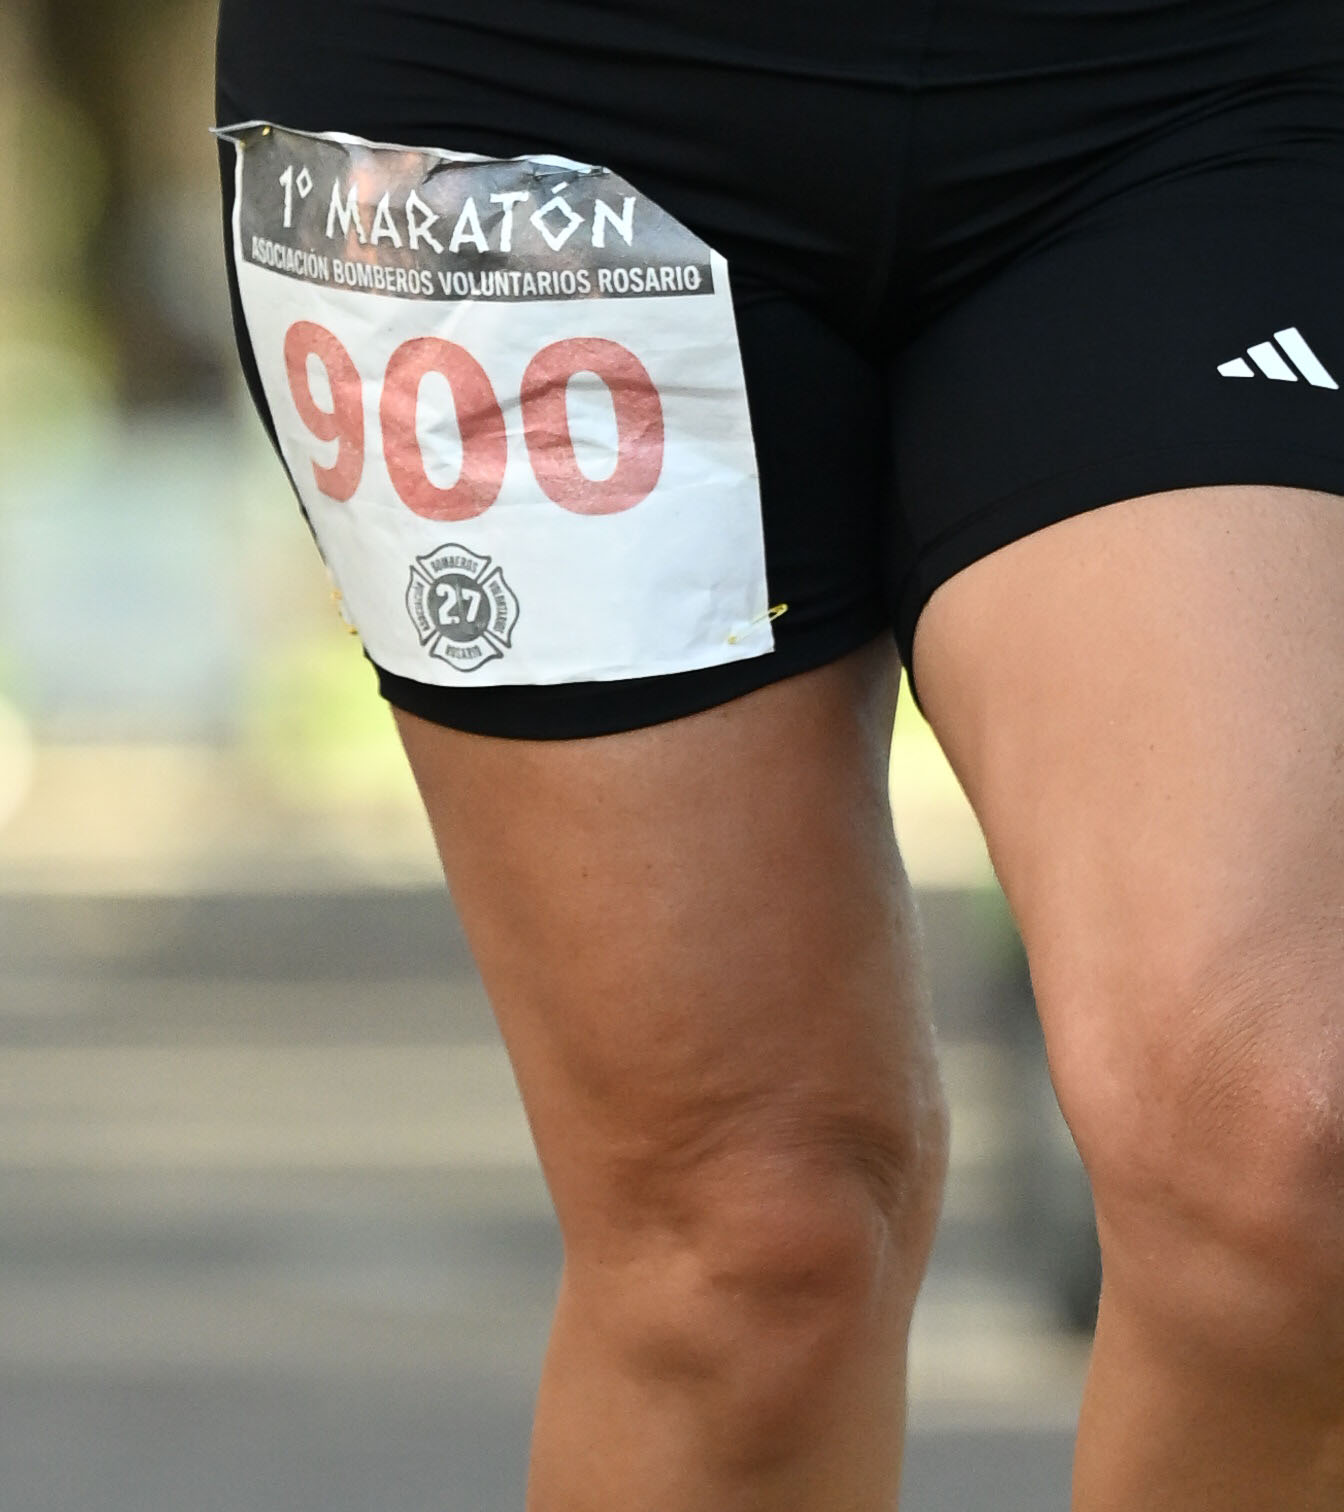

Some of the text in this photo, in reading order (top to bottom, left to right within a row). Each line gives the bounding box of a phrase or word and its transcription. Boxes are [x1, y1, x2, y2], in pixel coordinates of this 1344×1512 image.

[325, 177, 637, 254] MARATÓN
[251, 235, 703, 297] ASOCIACIÓN BOMBEROS VOLUNTARIOS ROSARIO
[283, 320, 666, 523] 900
[435, 582, 482, 626] 27
